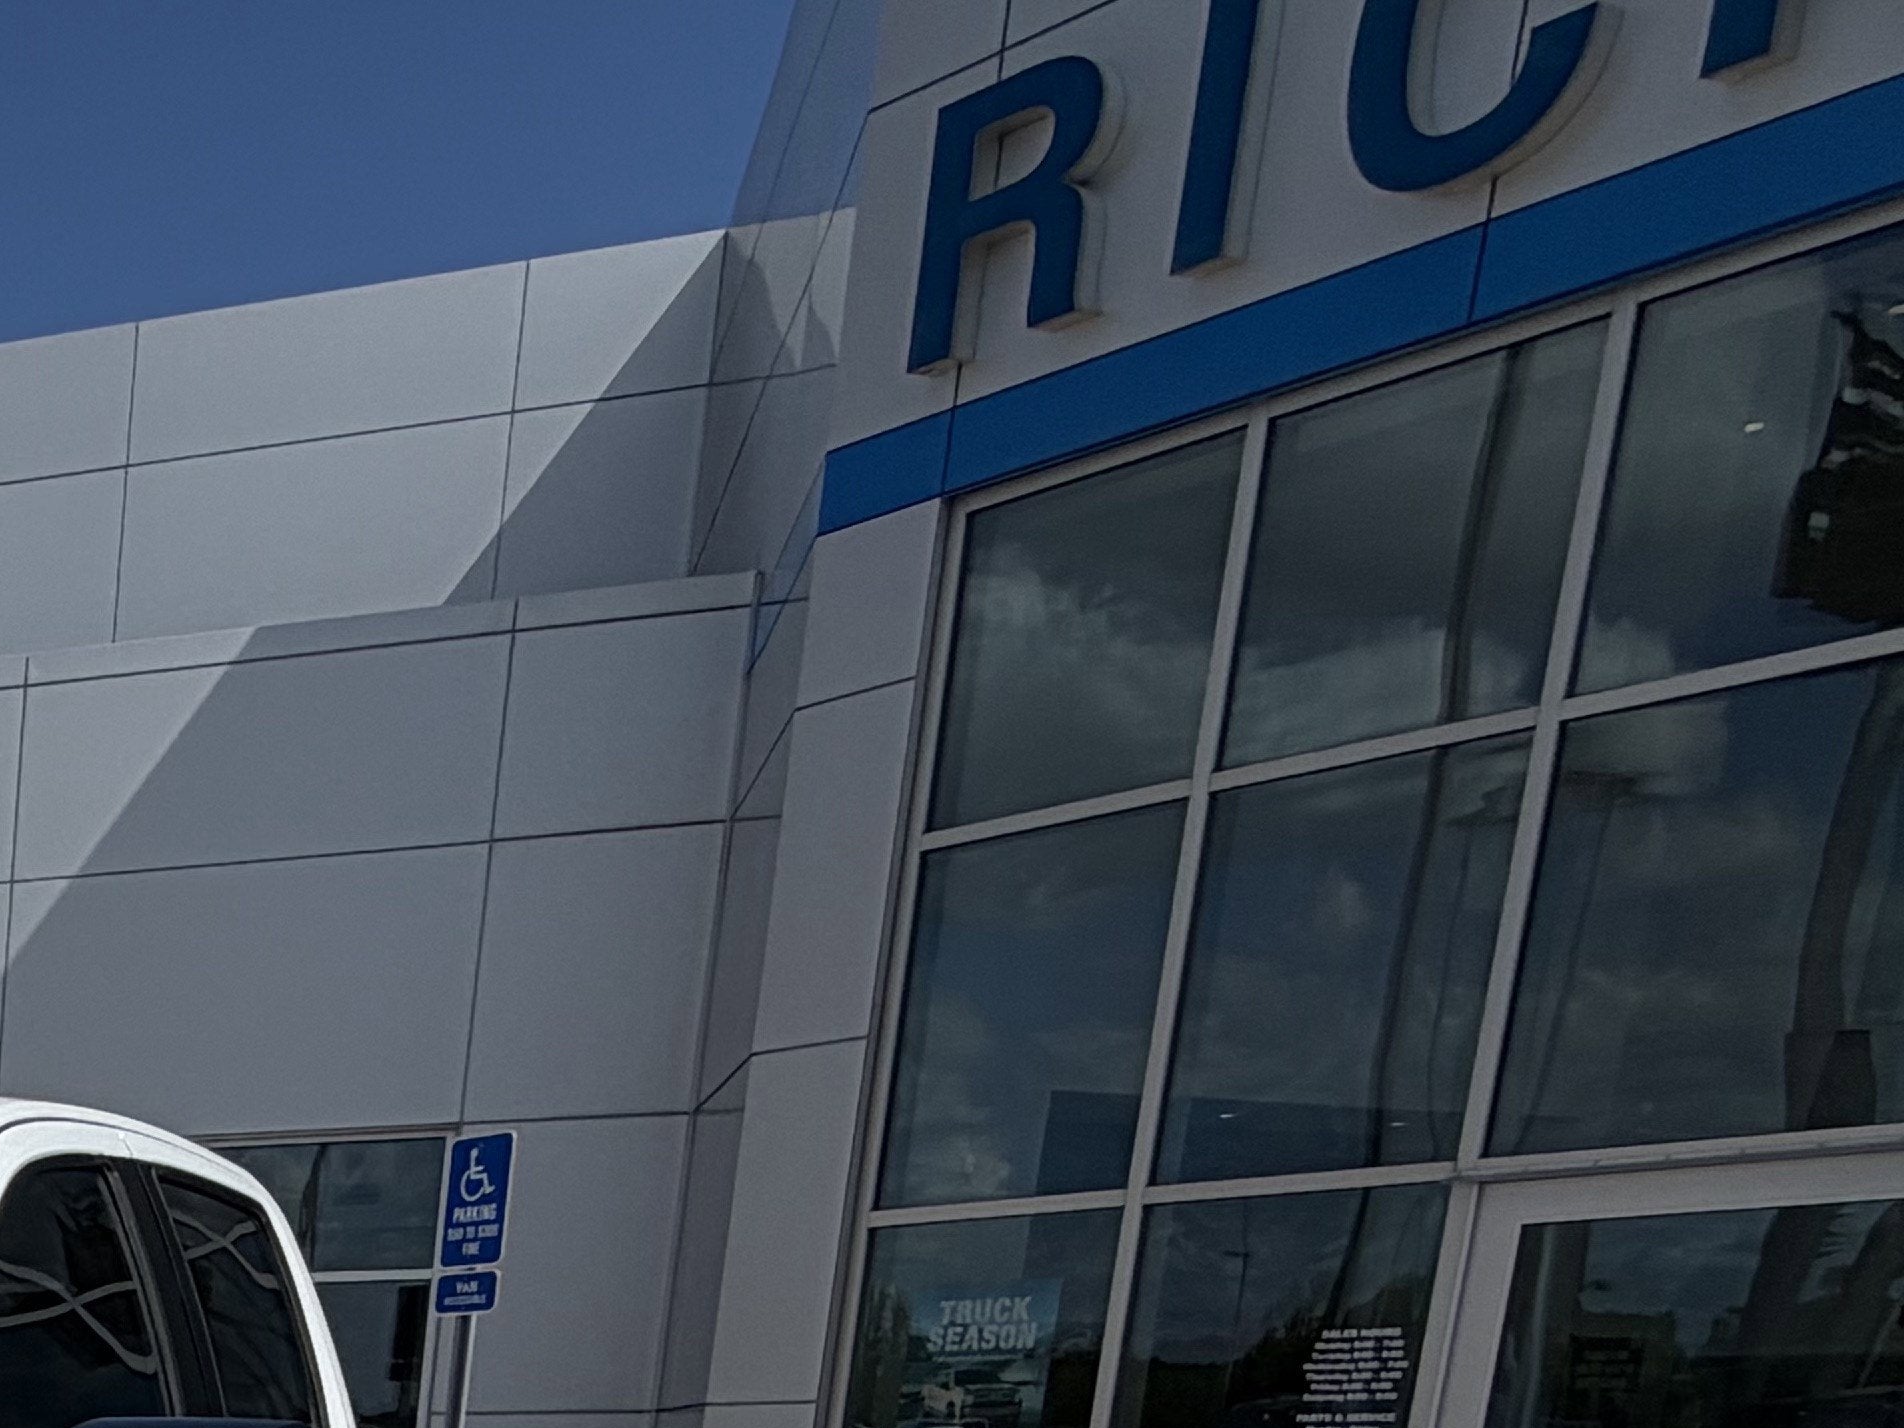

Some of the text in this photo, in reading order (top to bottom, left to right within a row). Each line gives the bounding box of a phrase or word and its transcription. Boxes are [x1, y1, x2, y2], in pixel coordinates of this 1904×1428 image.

[906, 0, 1774, 376] RIC
[453, 1203, 497, 1223] PARKING
[940, 1296, 1031, 1326] TRUCK
[926, 1322, 1037, 1352] SEASON
